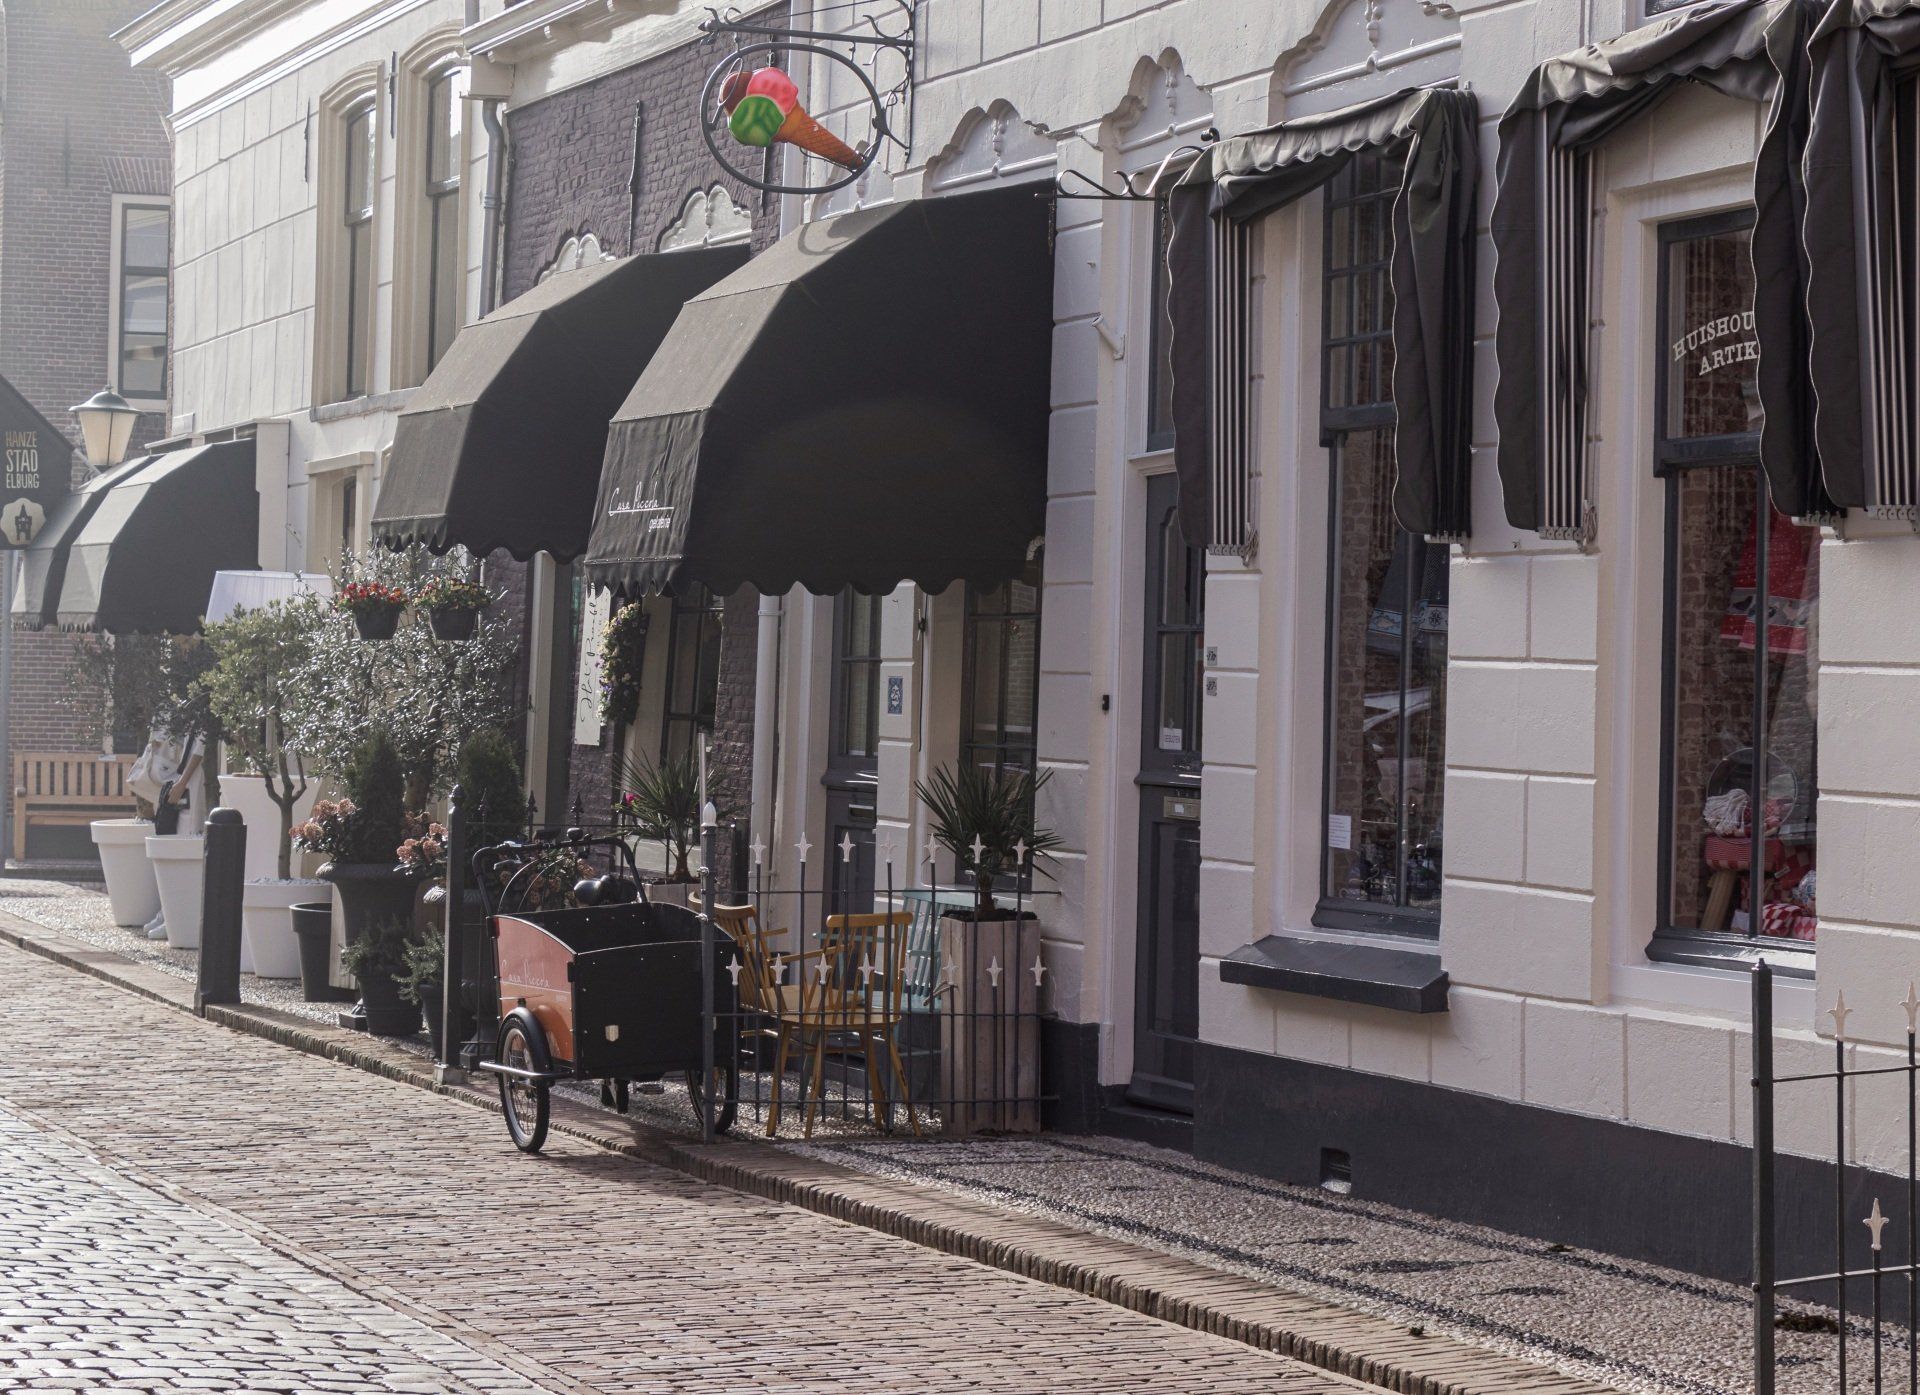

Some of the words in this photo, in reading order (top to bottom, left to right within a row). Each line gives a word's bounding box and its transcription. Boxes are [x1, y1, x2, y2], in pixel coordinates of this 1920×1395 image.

[1699, 341, 1757, 375] ARTIK
[6, 431, 37, 447] HANZE
[6, 449, 38, 472] STAD
[6, 473, 40, 488] ELBURG
